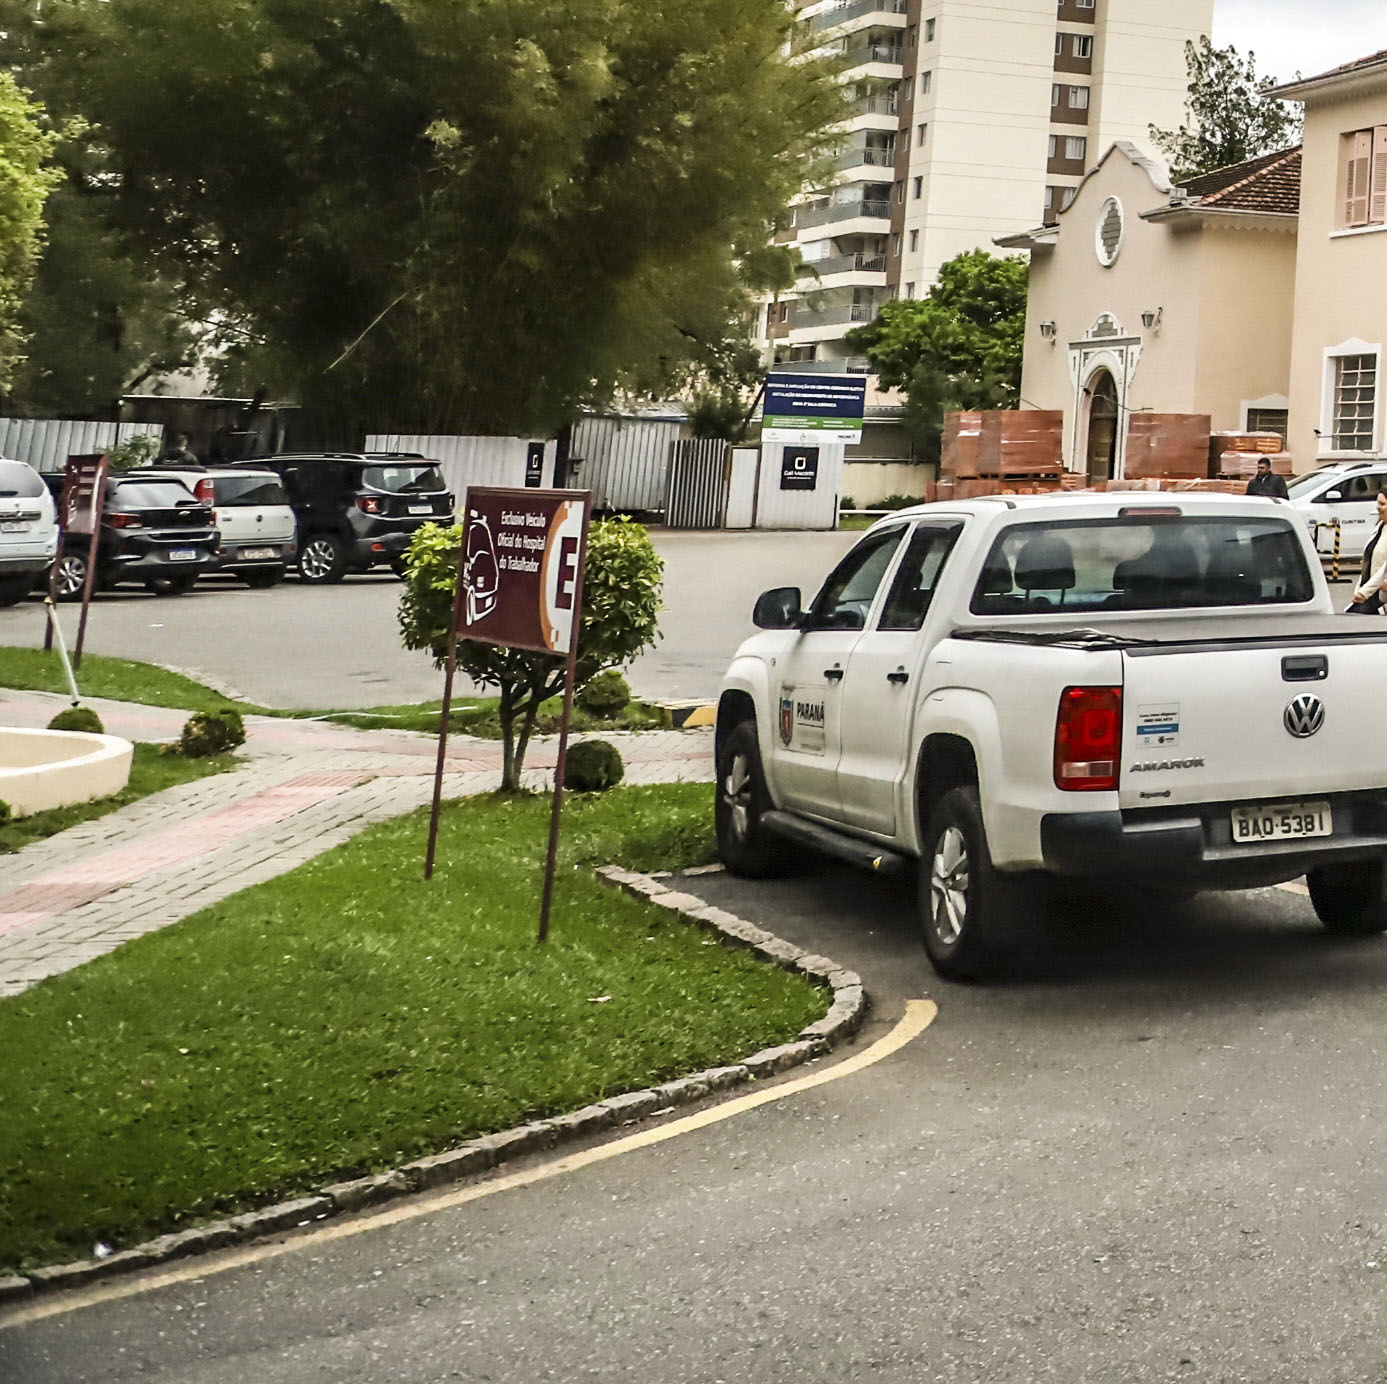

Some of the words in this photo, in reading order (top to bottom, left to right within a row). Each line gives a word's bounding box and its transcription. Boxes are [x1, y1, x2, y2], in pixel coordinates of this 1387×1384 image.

[501, 510, 525, 527] Exclusivo
[525, 512, 546, 528] Veículo
[497, 532, 515, 547] Oficial
[515, 535, 523, 548] do
[523, 535, 546, 553] Hospital
[499, 554, 507, 570] do
[507, 556, 540, 573] Trabalhador
[555, 536, 578, 610] E
[797, 701, 824, 721] PARANÁ
[1129, 756, 1206, 773] AMAROK
